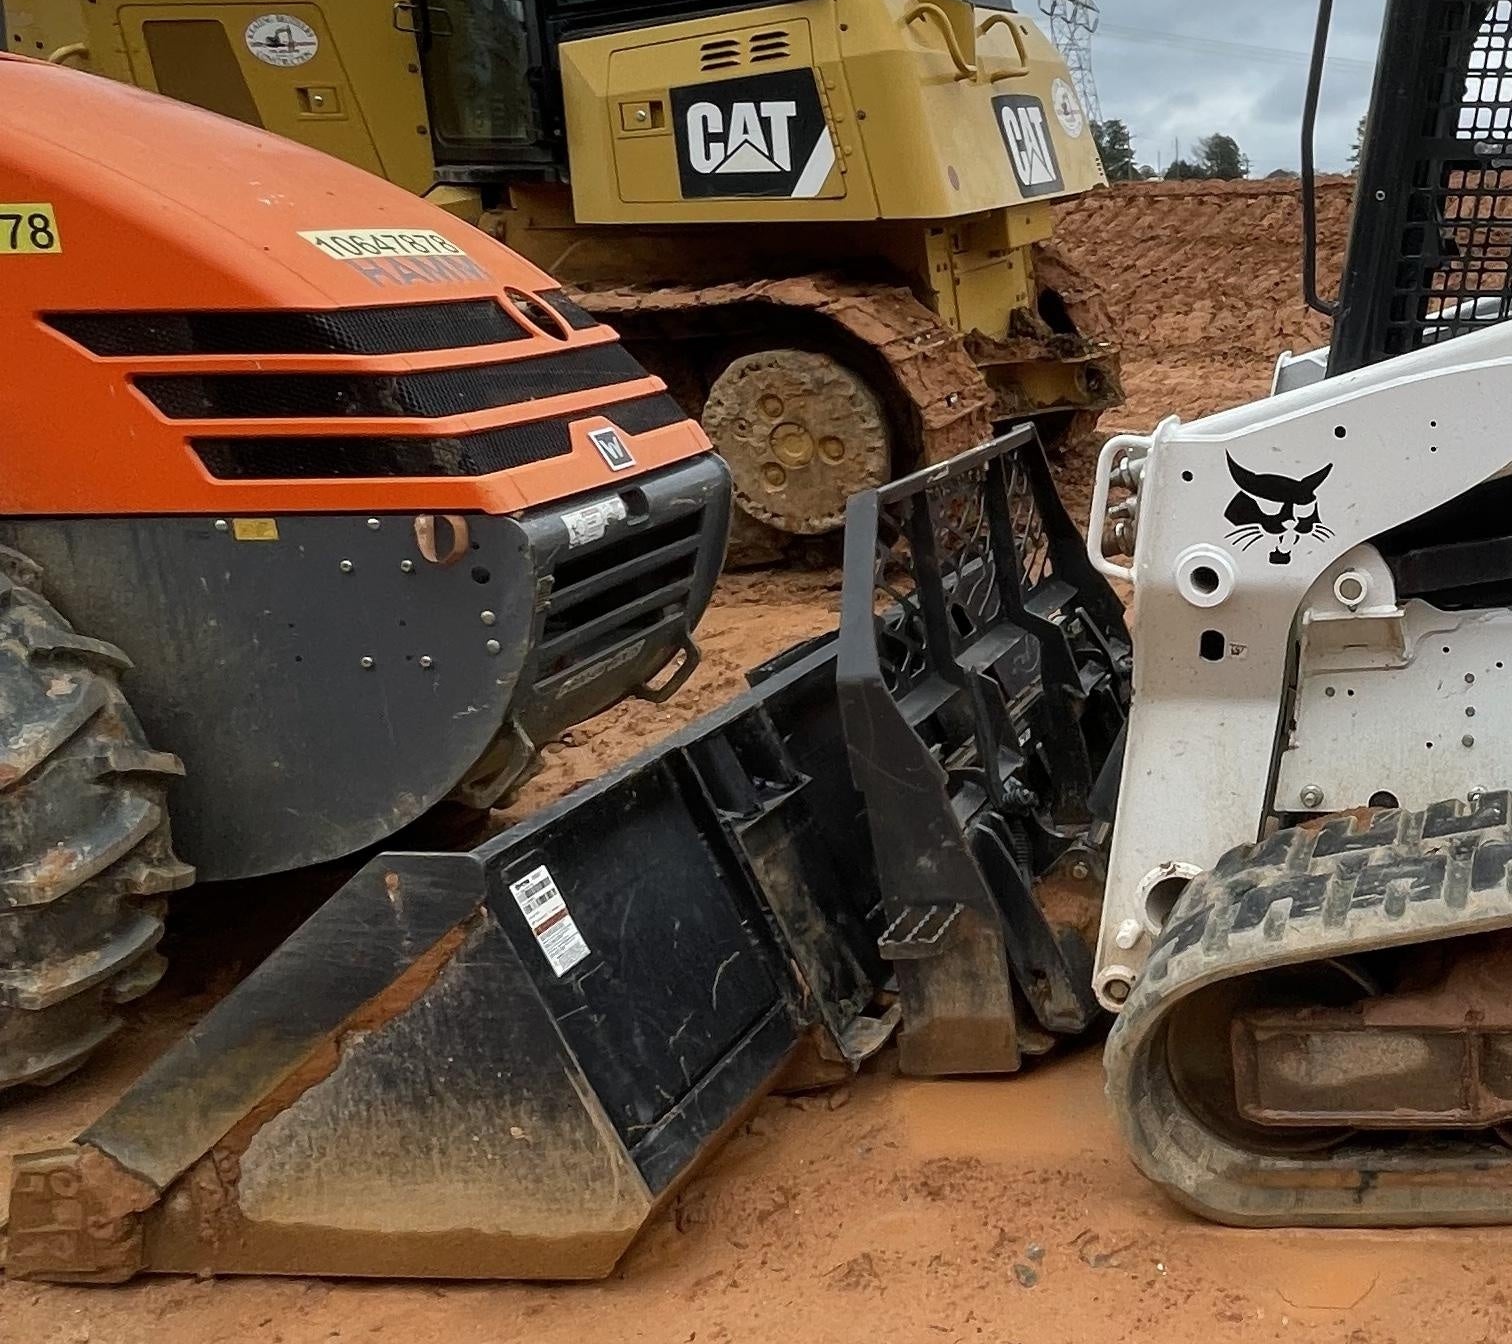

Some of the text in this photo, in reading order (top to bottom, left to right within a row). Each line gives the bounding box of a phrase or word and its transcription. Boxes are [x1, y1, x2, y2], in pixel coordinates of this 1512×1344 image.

[687, 101, 797, 174] CAT
[1001, 106, 1057, 186] CAT
[0, 213, 54, 250] 78
[316, 234, 460, 257] 10647878
